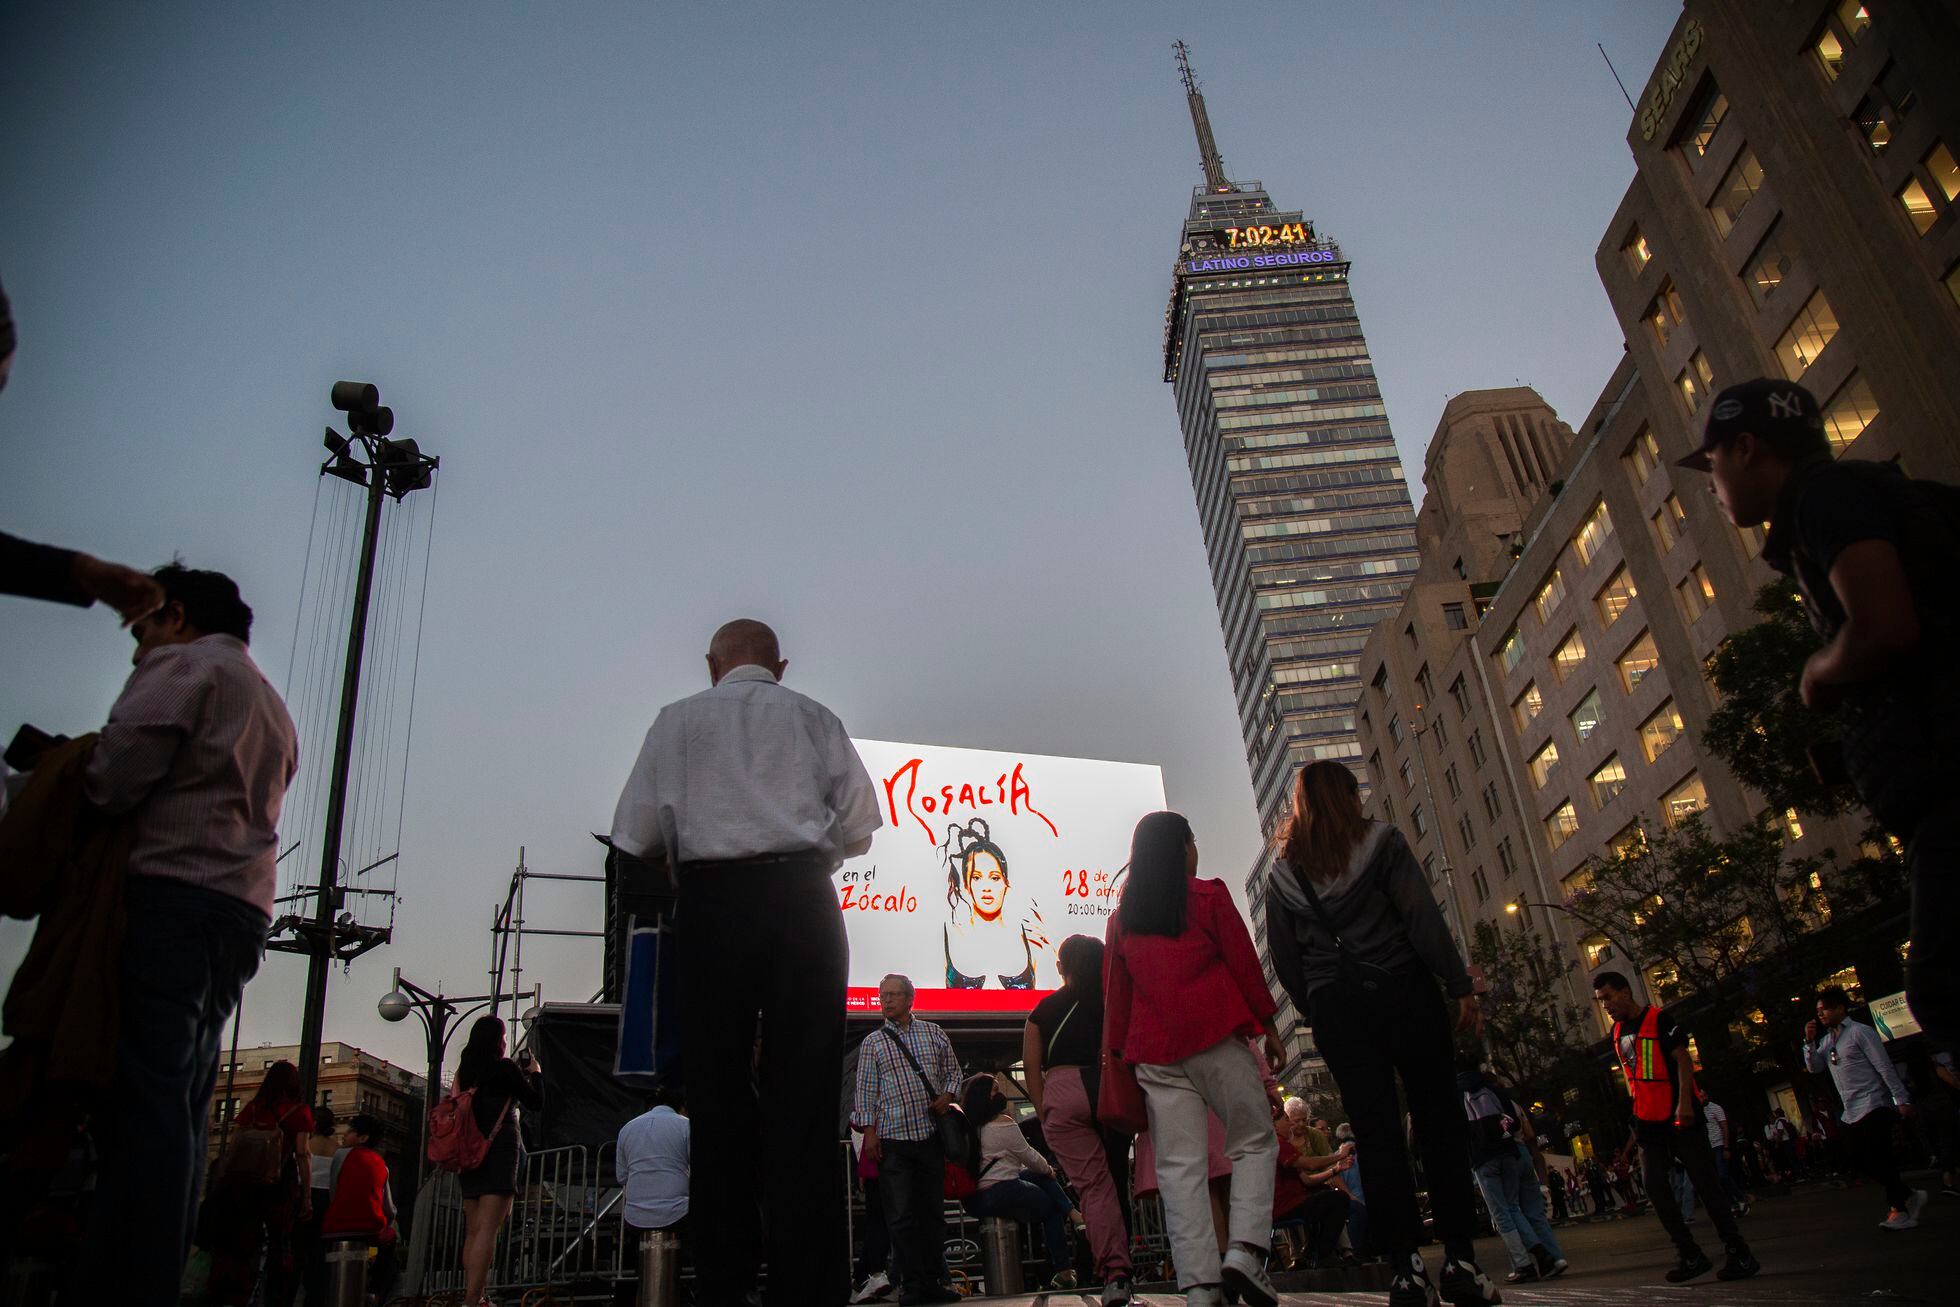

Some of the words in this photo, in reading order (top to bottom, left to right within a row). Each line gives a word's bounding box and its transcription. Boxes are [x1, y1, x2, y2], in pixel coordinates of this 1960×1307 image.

[1641, 19, 1704, 140] SEARS
[1225, 223, 1306, 247] 7:02:41
[1191, 257, 1250, 272] LATINO
[1254, 251, 1334, 267] SEGUROS
[842, 871, 859, 882] en
[864, 865, 876, 881] el
[1063, 869, 1089, 898] 28
[1094, 869, 1109, 883] de
[841, 884, 917, 912] Zócalo
[1068, 903, 1096, 915] 20:00
